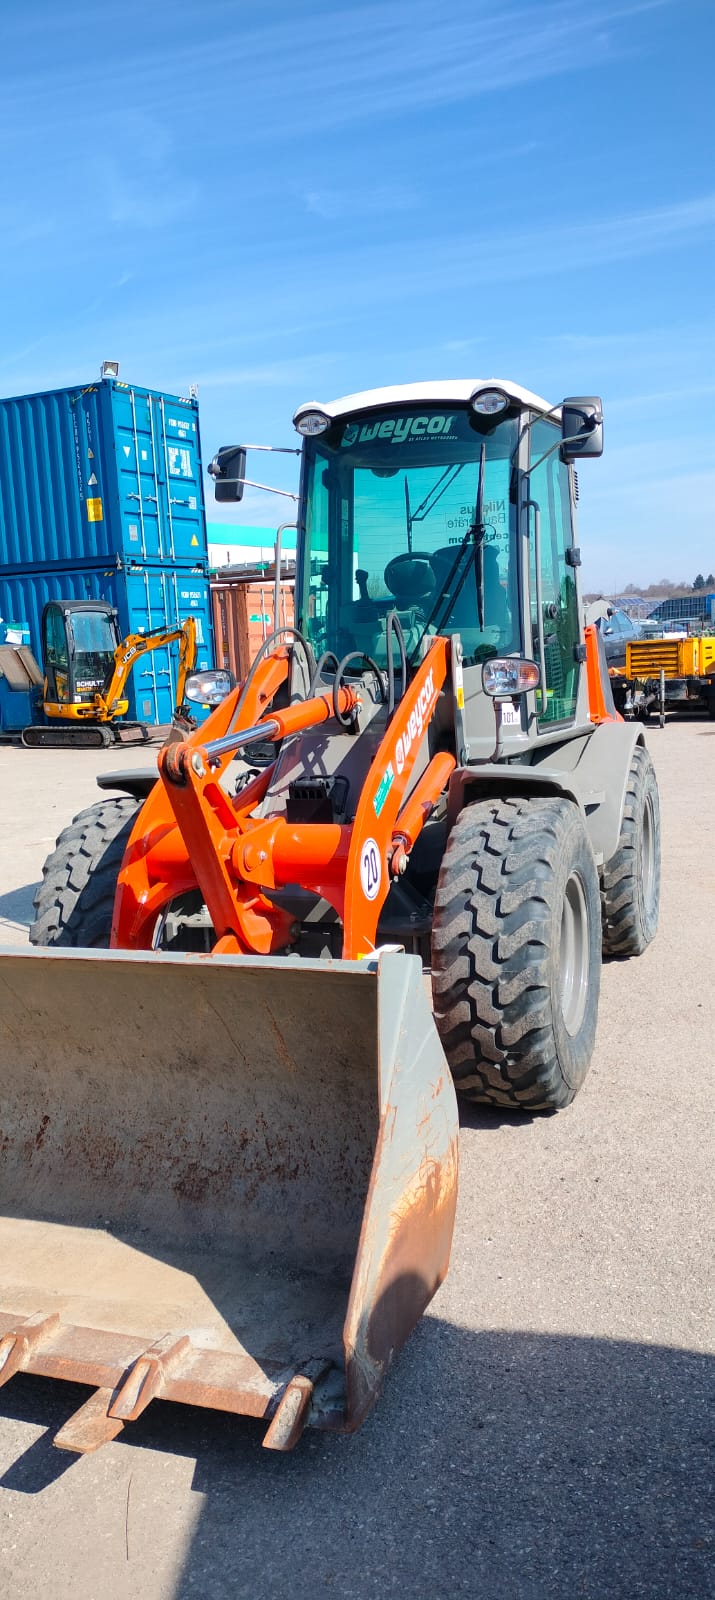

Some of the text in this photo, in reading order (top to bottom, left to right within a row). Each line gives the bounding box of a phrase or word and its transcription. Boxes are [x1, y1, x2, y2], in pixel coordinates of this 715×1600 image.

[359, 416, 457, 443] weycor
[402, 666, 434, 758] weycor
[503, 712, 514, 723] 101
[364, 847, 378, 891] 20
